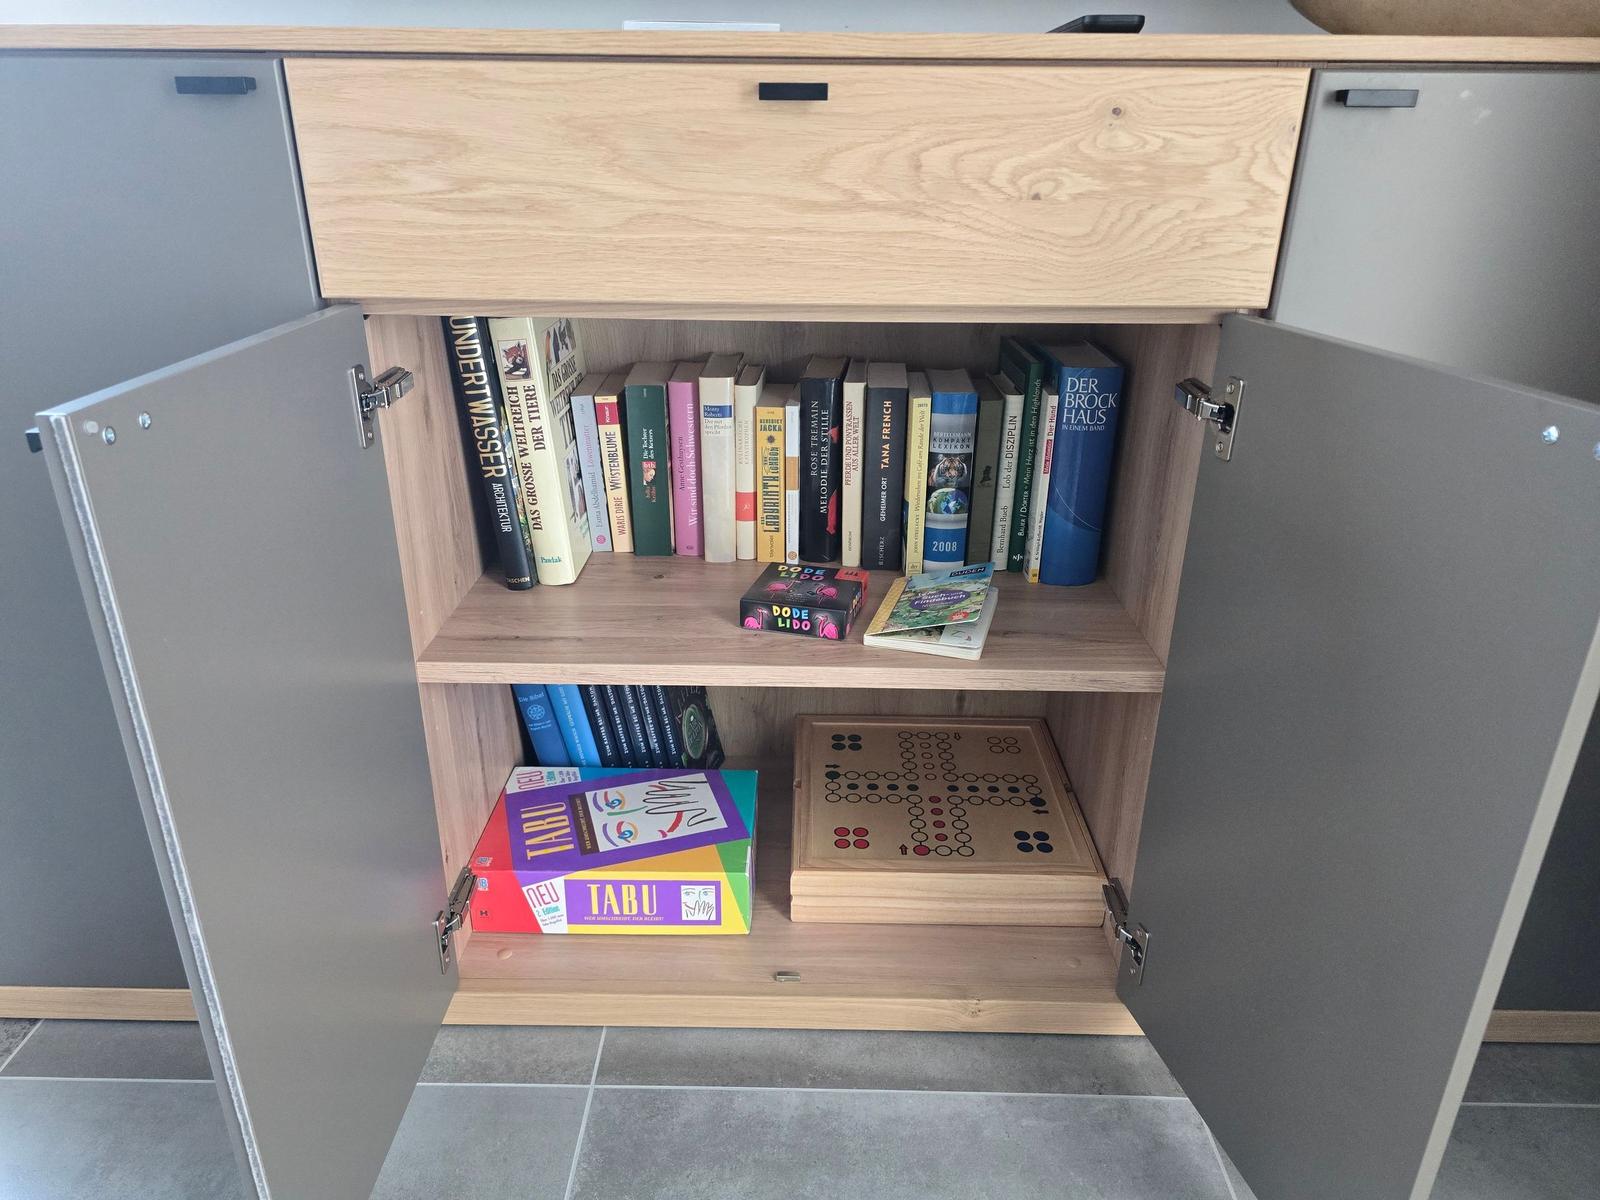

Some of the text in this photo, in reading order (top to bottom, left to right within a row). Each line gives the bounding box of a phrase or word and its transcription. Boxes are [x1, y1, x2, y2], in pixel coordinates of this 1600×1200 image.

[1067, 378, 1098, 393] DER
[450, 316, 507, 478] UNDERTWASSER
[1064, 392, 1118, 409] BROCK
[524, 384, 546, 452] DER TIERE
[882, 400, 892, 440] FRENCH
[1063, 408, 1106, 424] HAUS
[1024, 467, 1032, 484] Mein
[1032, 379, 1041, 414] Highlands
[506, 386, 543, 530] DAS GROSSE WELTREICH
[686, 403, 698, 526] Wir sind doch Schwestern
[769, 446, 779, 474] LONDON
[810, 452, 818, 476] ROSE
[820, 409, 829, 514] MELODIE DER STILLE
[881, 444, 890, 469] TANA
[605, 432, 626, 536] WARIS DIRIE WÜSTENBLUME
[844, 466, 852, 486] PFERDE
[996, 416, 1017, 554] Bernhard Bueb Lob der DISZIPLIN
[492, 483, 512, 532] ARCHITEKTUR
[762, 476, 780, 533] LABYRINTH
[932, 542, 957, 552] 2008
[778, 565, 827, 575] DODE
[780, 572, 824, 580] LIDO
[772, 605, 808, 619] DODE
[778, 618, 811, 630] LIDO
[598, 726, 610, 744] KAFFEE
[615, 724, 627, 742] KAFFEE
[633, 723, 645, 742] KAFFEE
[648, 724, 659, 742] KAFFEE
[664, 725, 675, 743] KAFFEE
[621, 743, 630, 754] ZUM
[639, 742, 647, 753] ZUM
[653, 742, 661, 754] ZUM
[669, 744, 677, 755] ZUM
[517, 770, 545, 790] NEU
[520, 802, 574, 860] TABU
[526, 882, 560, 908] NEU
[587, 884, 657, 915] TABU
